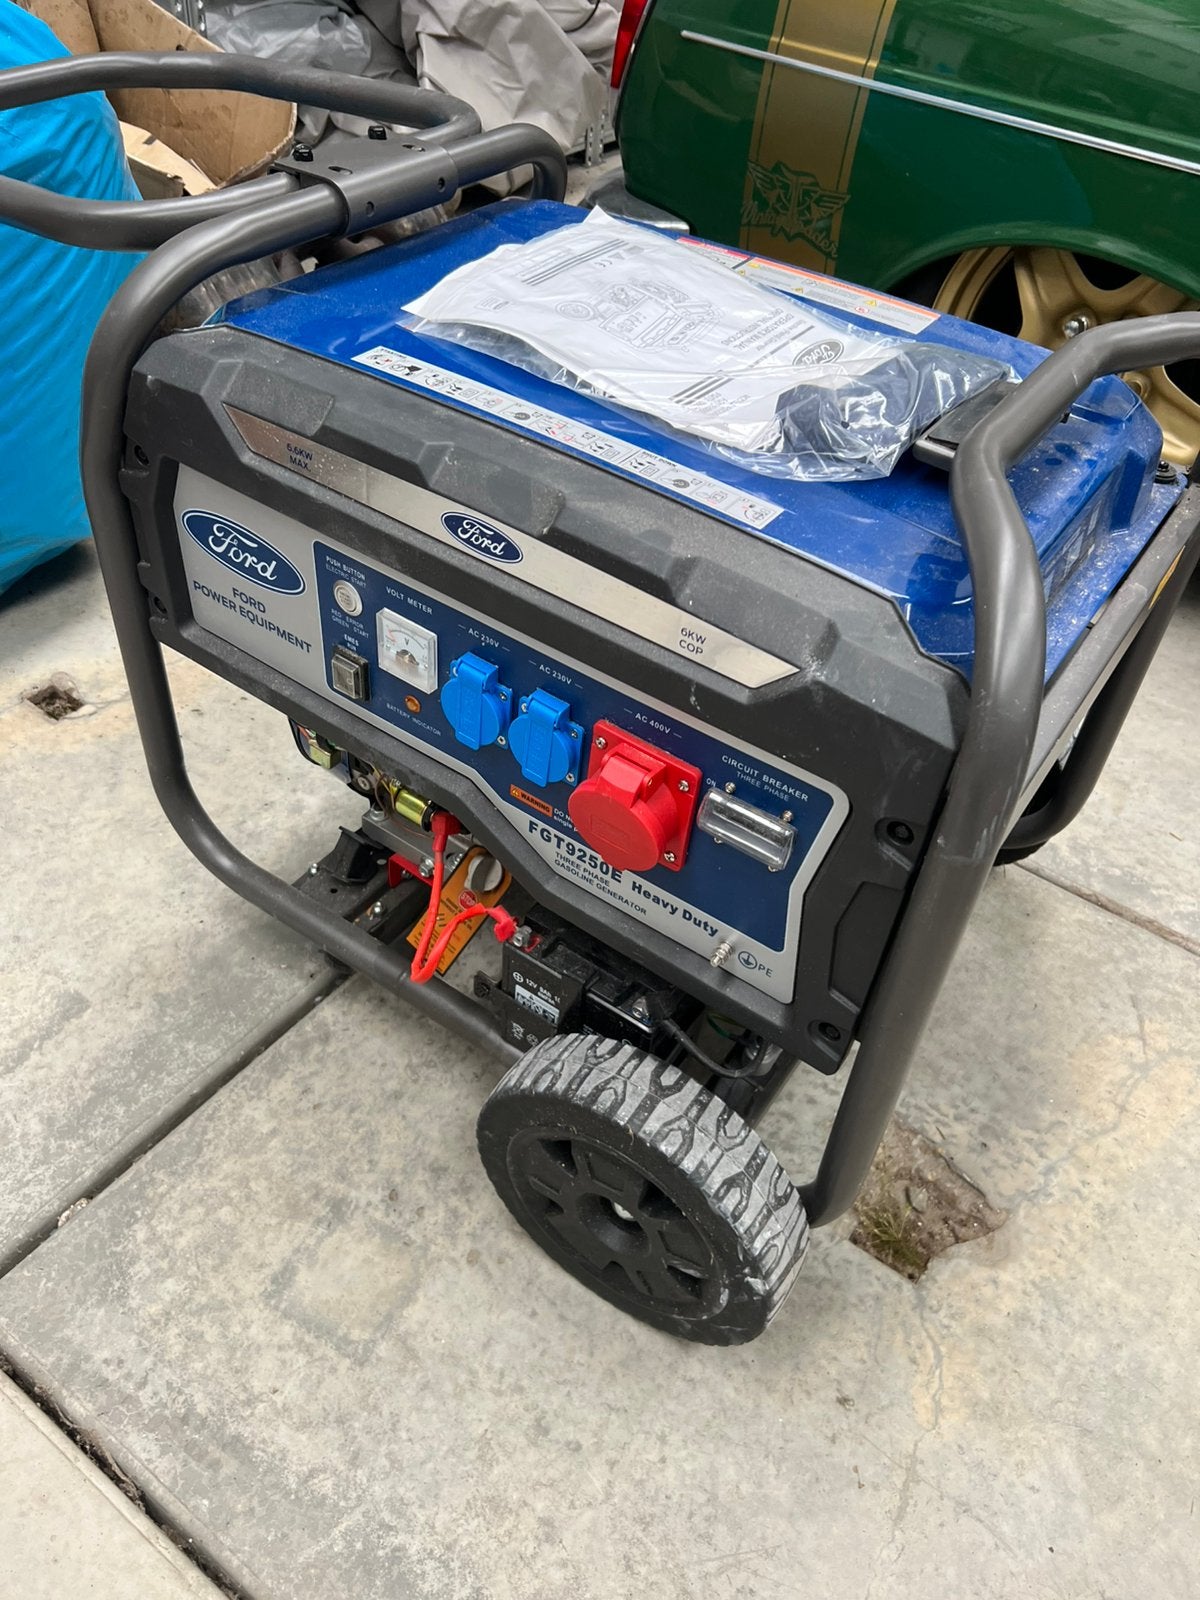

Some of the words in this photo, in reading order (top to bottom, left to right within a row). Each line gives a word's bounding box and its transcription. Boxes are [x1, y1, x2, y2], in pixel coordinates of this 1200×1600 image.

[802, 344, 834, 365] Ford
[458, 519, 506, 555] Ford
[208, 524, 277, 582] Ford
[325, 564, 350, 581] ELECTRIC
[351, 575, 367, 588] START
[326, 556, 341, 569] PUSH
[342, 562, 366, 580] BUTTON
[232, 587, 267, 614] FORD
[386, 586, 404, 600] VOLT
[407, 596, 433, 615] METER
[192, 580, 237, 614] POWER
[238, 606, 312, 654] EQUIPMENT
[468, 627, 480, 639] AC
[481, 633, 500, 648] 230V
[679, 639, 703, 655] COP
[680, 627, 706, 645] 6KW
[539, 664, 551, 676] AC
[552, 670, 572, 685] 230V
[386, 703, 410, 719] BATTERY
[411, 717, 441, 737] INDICATOR
[635, 712, 648, 724] AC
[649, 719, 671, 735] 400V
[706, 777, 717, 788] ON
[721, 755, 759, 777] CIRCUIT
[762, 774, 809, 802] BREAKER
[736, 771, 761, 788] THREE
[763, 784, 790, 802] PHASE
[520, 791, 551, 812] WARNING
[553, 808, 564, 817] DO
[528, 820, 623, 883] FGT9250E
[554, 852, 581, 872] THREE
[582, 866, 611, 888] PHASE
[460, 893, 476, 906] STOP
[553, 859, 595, 889] GASOLINE
[596, 881, 648, 916] GENERATOR
[631, 880, 678, 915] Heavy
[682, 909, 720, 938] Duty
[758, 963, 773, 978] PE
